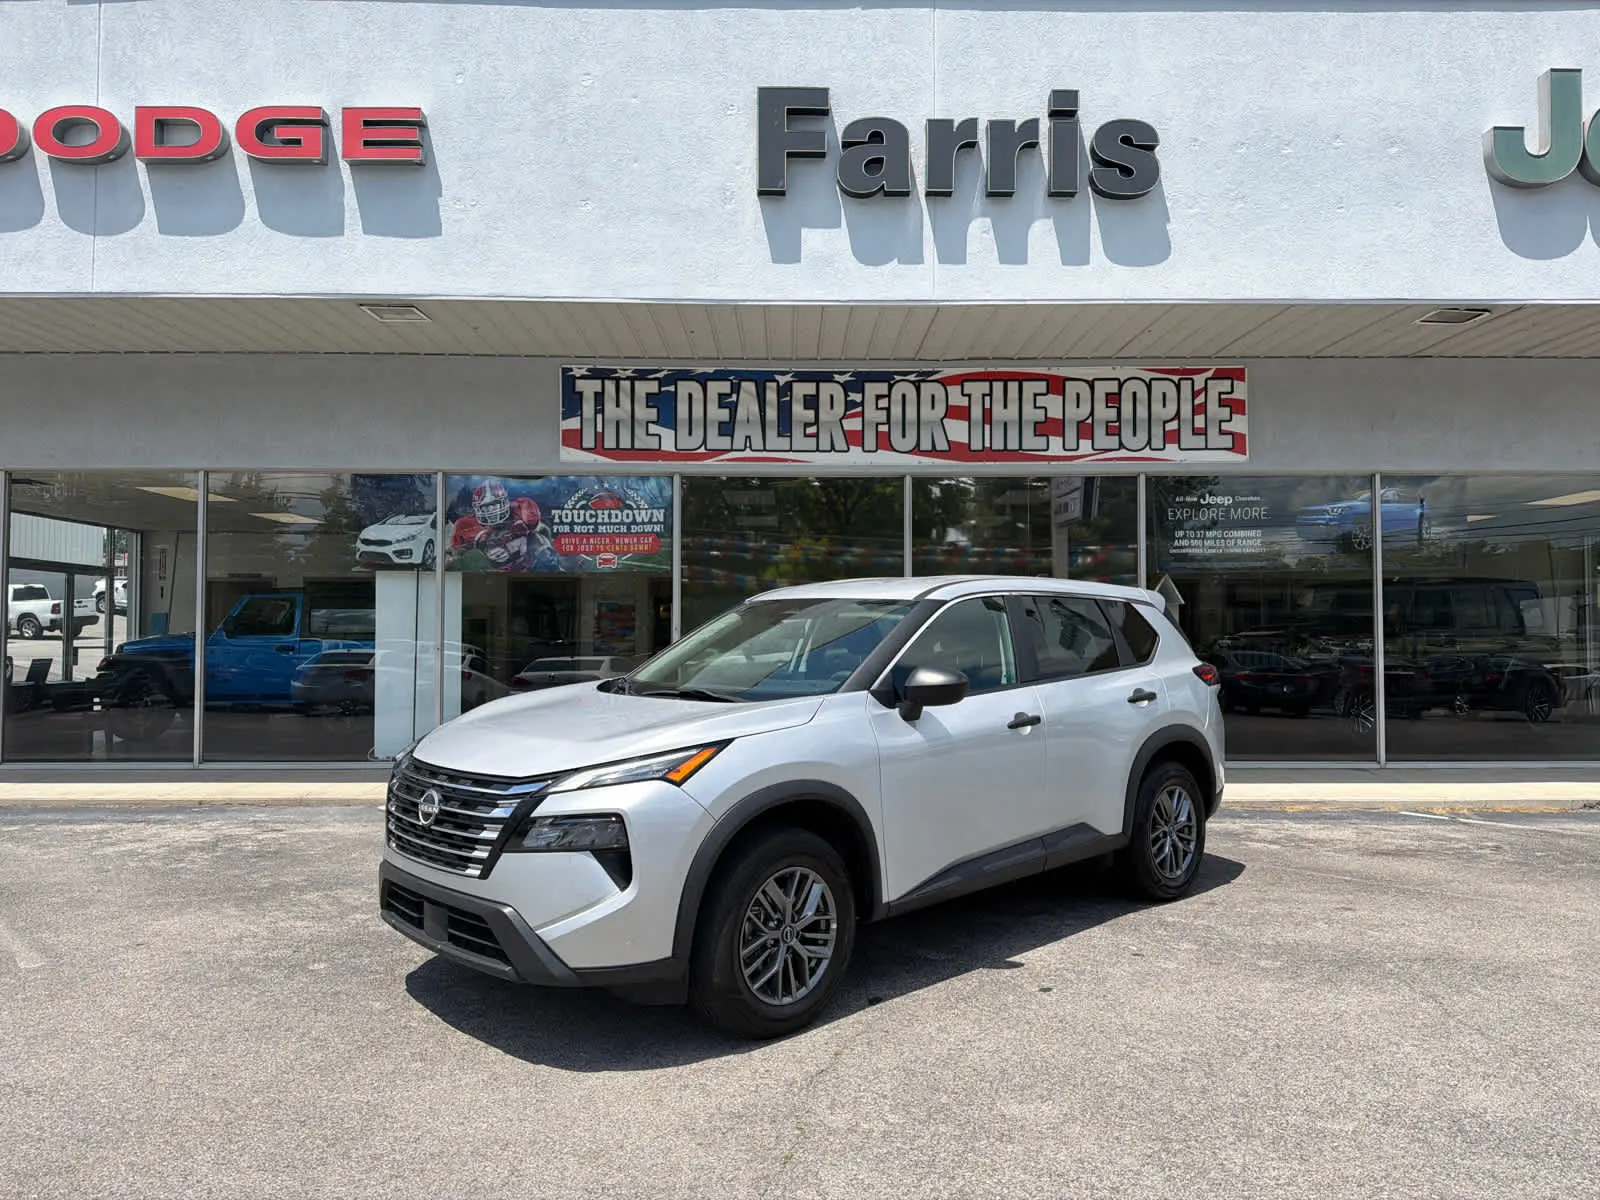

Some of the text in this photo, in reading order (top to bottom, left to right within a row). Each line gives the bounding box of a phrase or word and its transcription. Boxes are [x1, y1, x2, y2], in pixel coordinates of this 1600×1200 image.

[0, 105, 425, 166] ODGE
[1481, 68, 1600, 190] J
[757, 86, 1160, 200] Farris
[574, 377, 1234, 453] THE DEALER FOR THE PEOPLE
[1200, 493, 1233, 506] Jeep
[551, 509, 665, 523] TOUCHDOWN
[1168, 507, 1226, 520] EXPLORE
[553, 524, 664, 533] FOR NOT MUCH DOWN!
[1175, 530, 1185, 538] UP
[1186, 530, 1195, 538] TO
[1206, 530, 1223, 538] MPG
[1223, 530, 1262, 538] COMBINED
